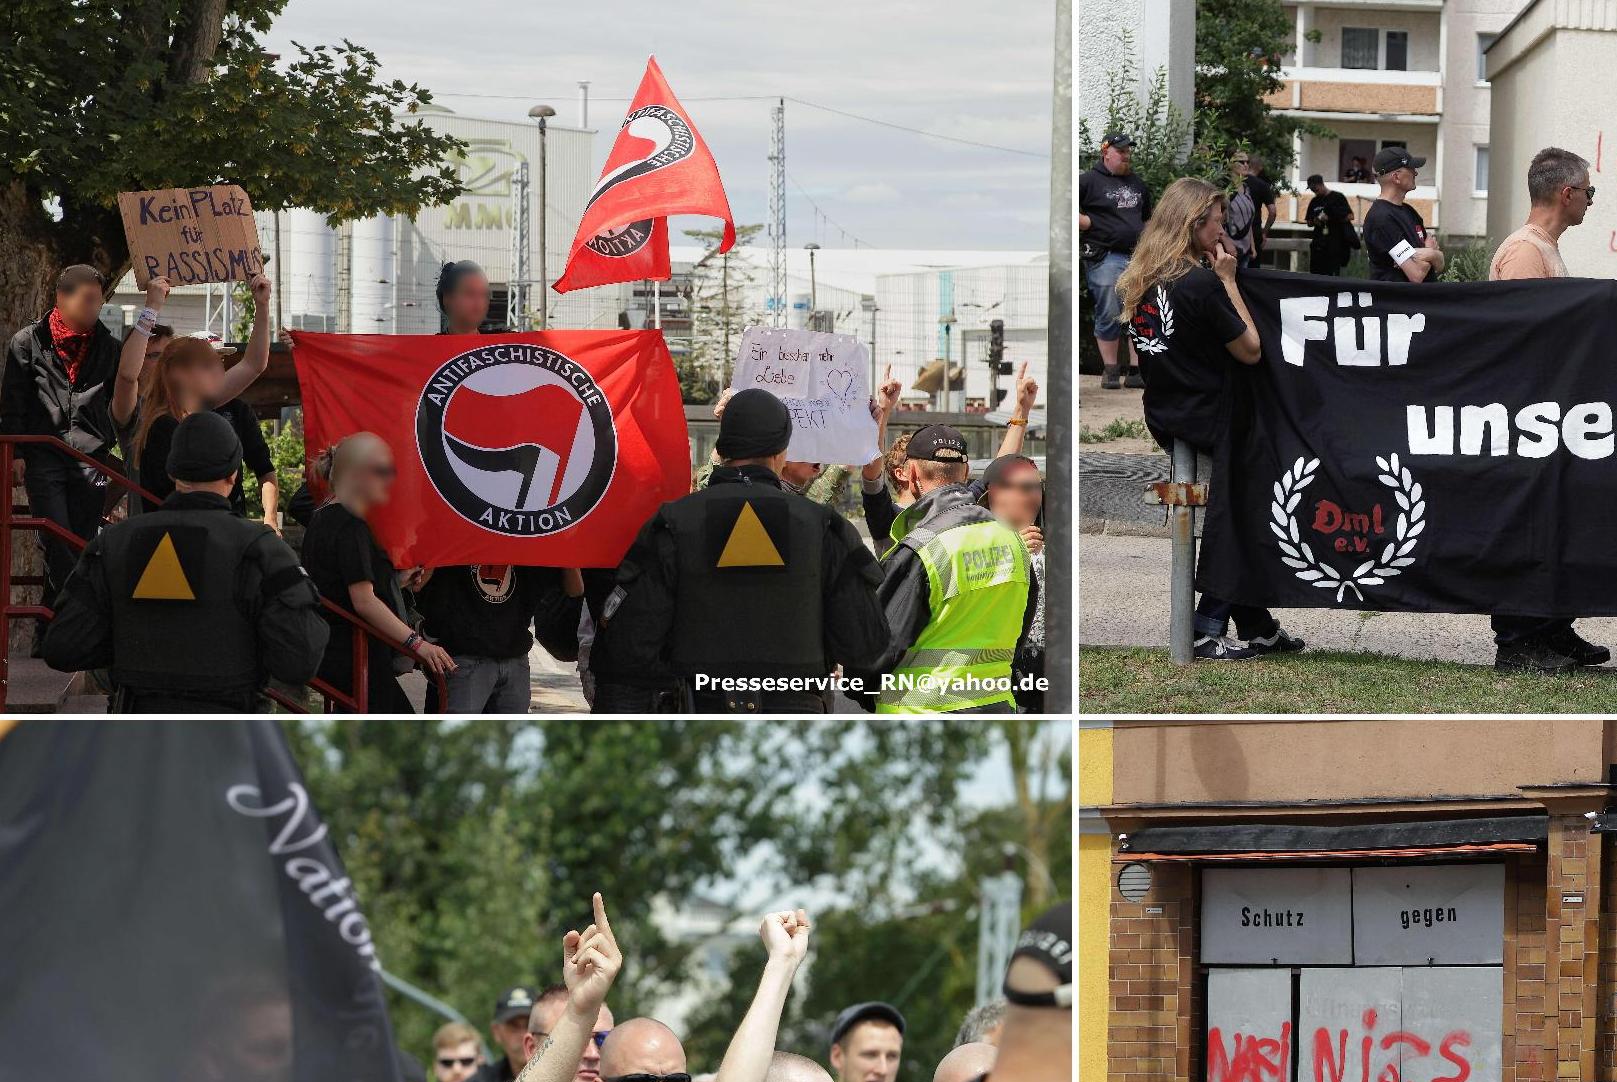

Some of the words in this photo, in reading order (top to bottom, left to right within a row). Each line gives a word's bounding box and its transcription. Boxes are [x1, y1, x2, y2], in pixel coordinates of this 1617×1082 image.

[139, 196, 191, 225] Kein
[181, 225, 203, 244] für
[145, 247, 264, 282] RASSISMUS
[1279, 292, 1426, 367] Für
[427, 348, 601, 406] ANTIFASCHISTISCHE
[480, 507, 572, 531] AKTION
[1241, 907, 1304, 927] Schutz
[1400, 906, 1457, 929] gegen
